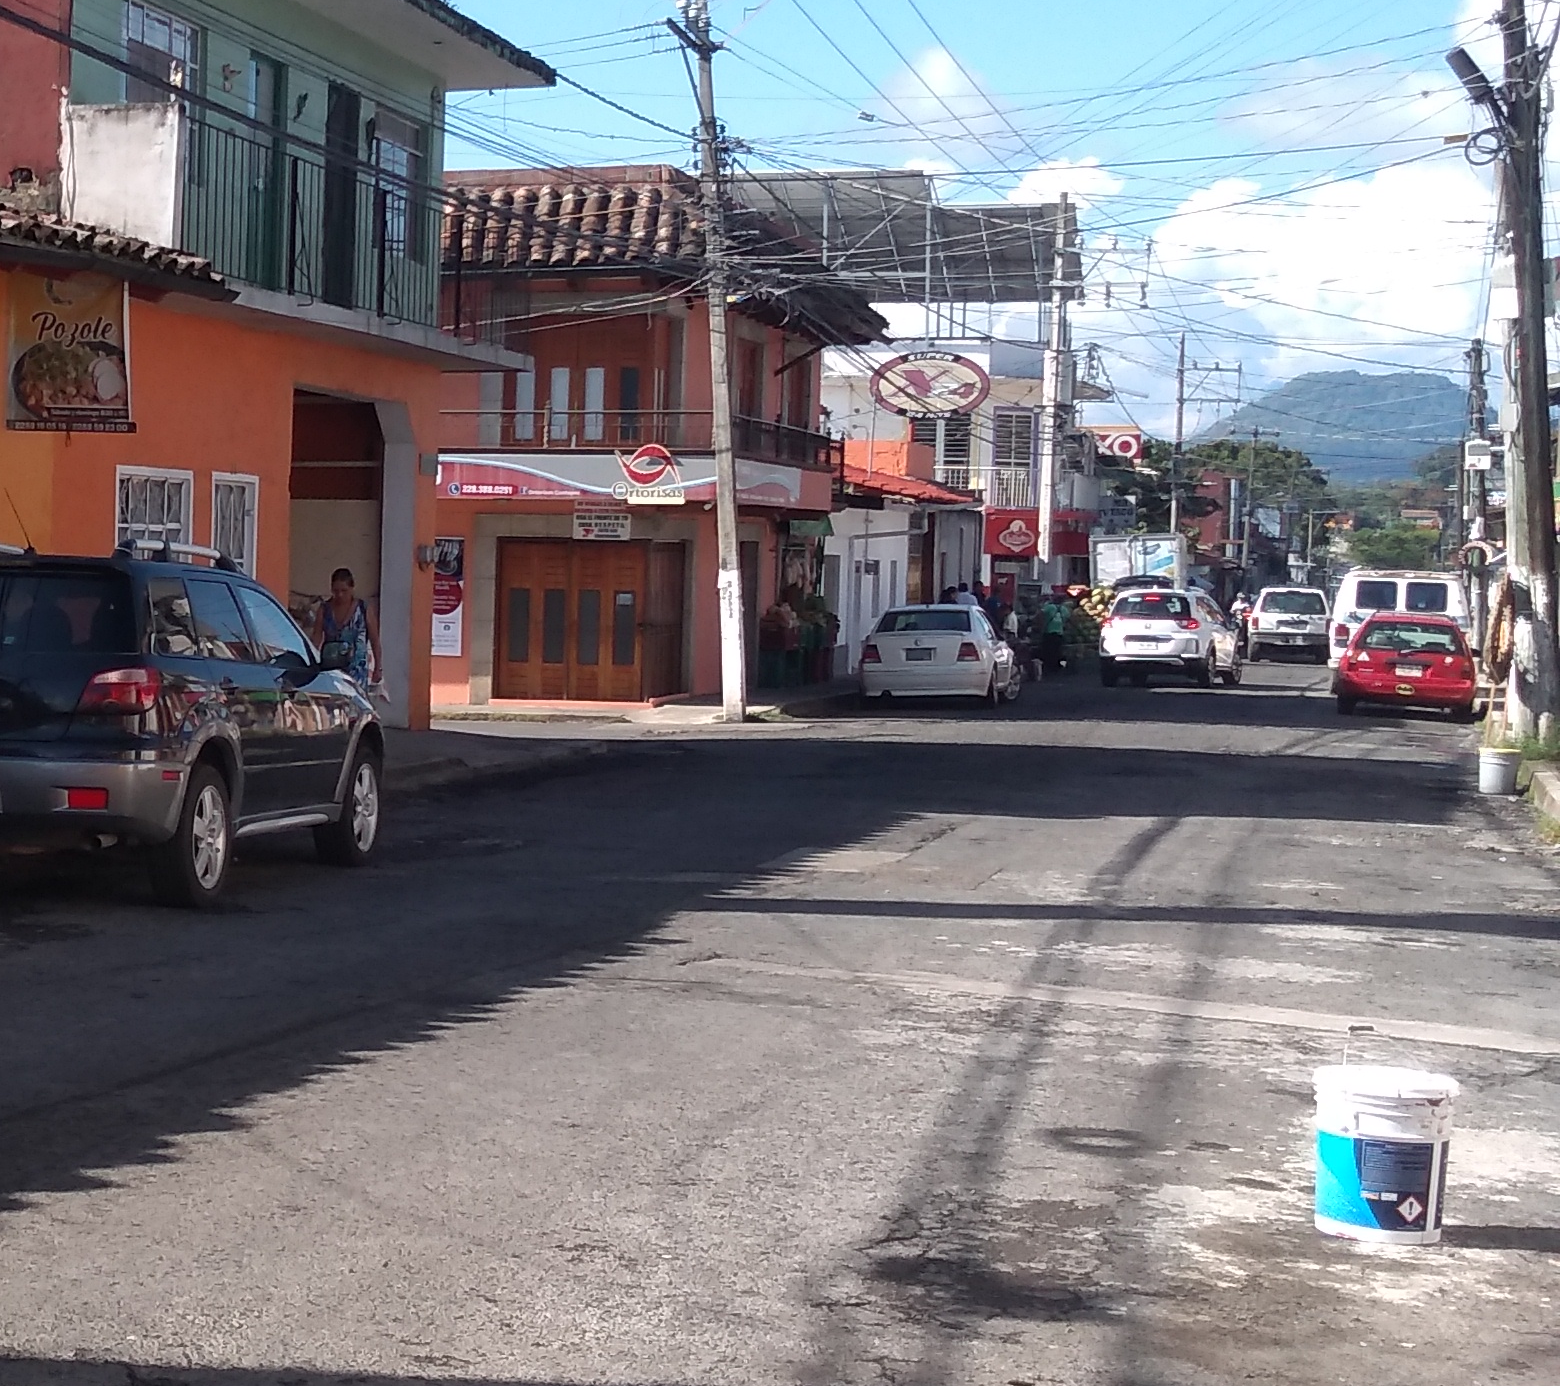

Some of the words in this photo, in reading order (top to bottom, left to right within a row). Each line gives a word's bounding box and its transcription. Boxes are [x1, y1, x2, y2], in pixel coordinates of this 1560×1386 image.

[31, 311, 114, 348] Pozole
[907, 353, 955, 362] SUPER
[613, 482, 683, 498] Ortorisas
